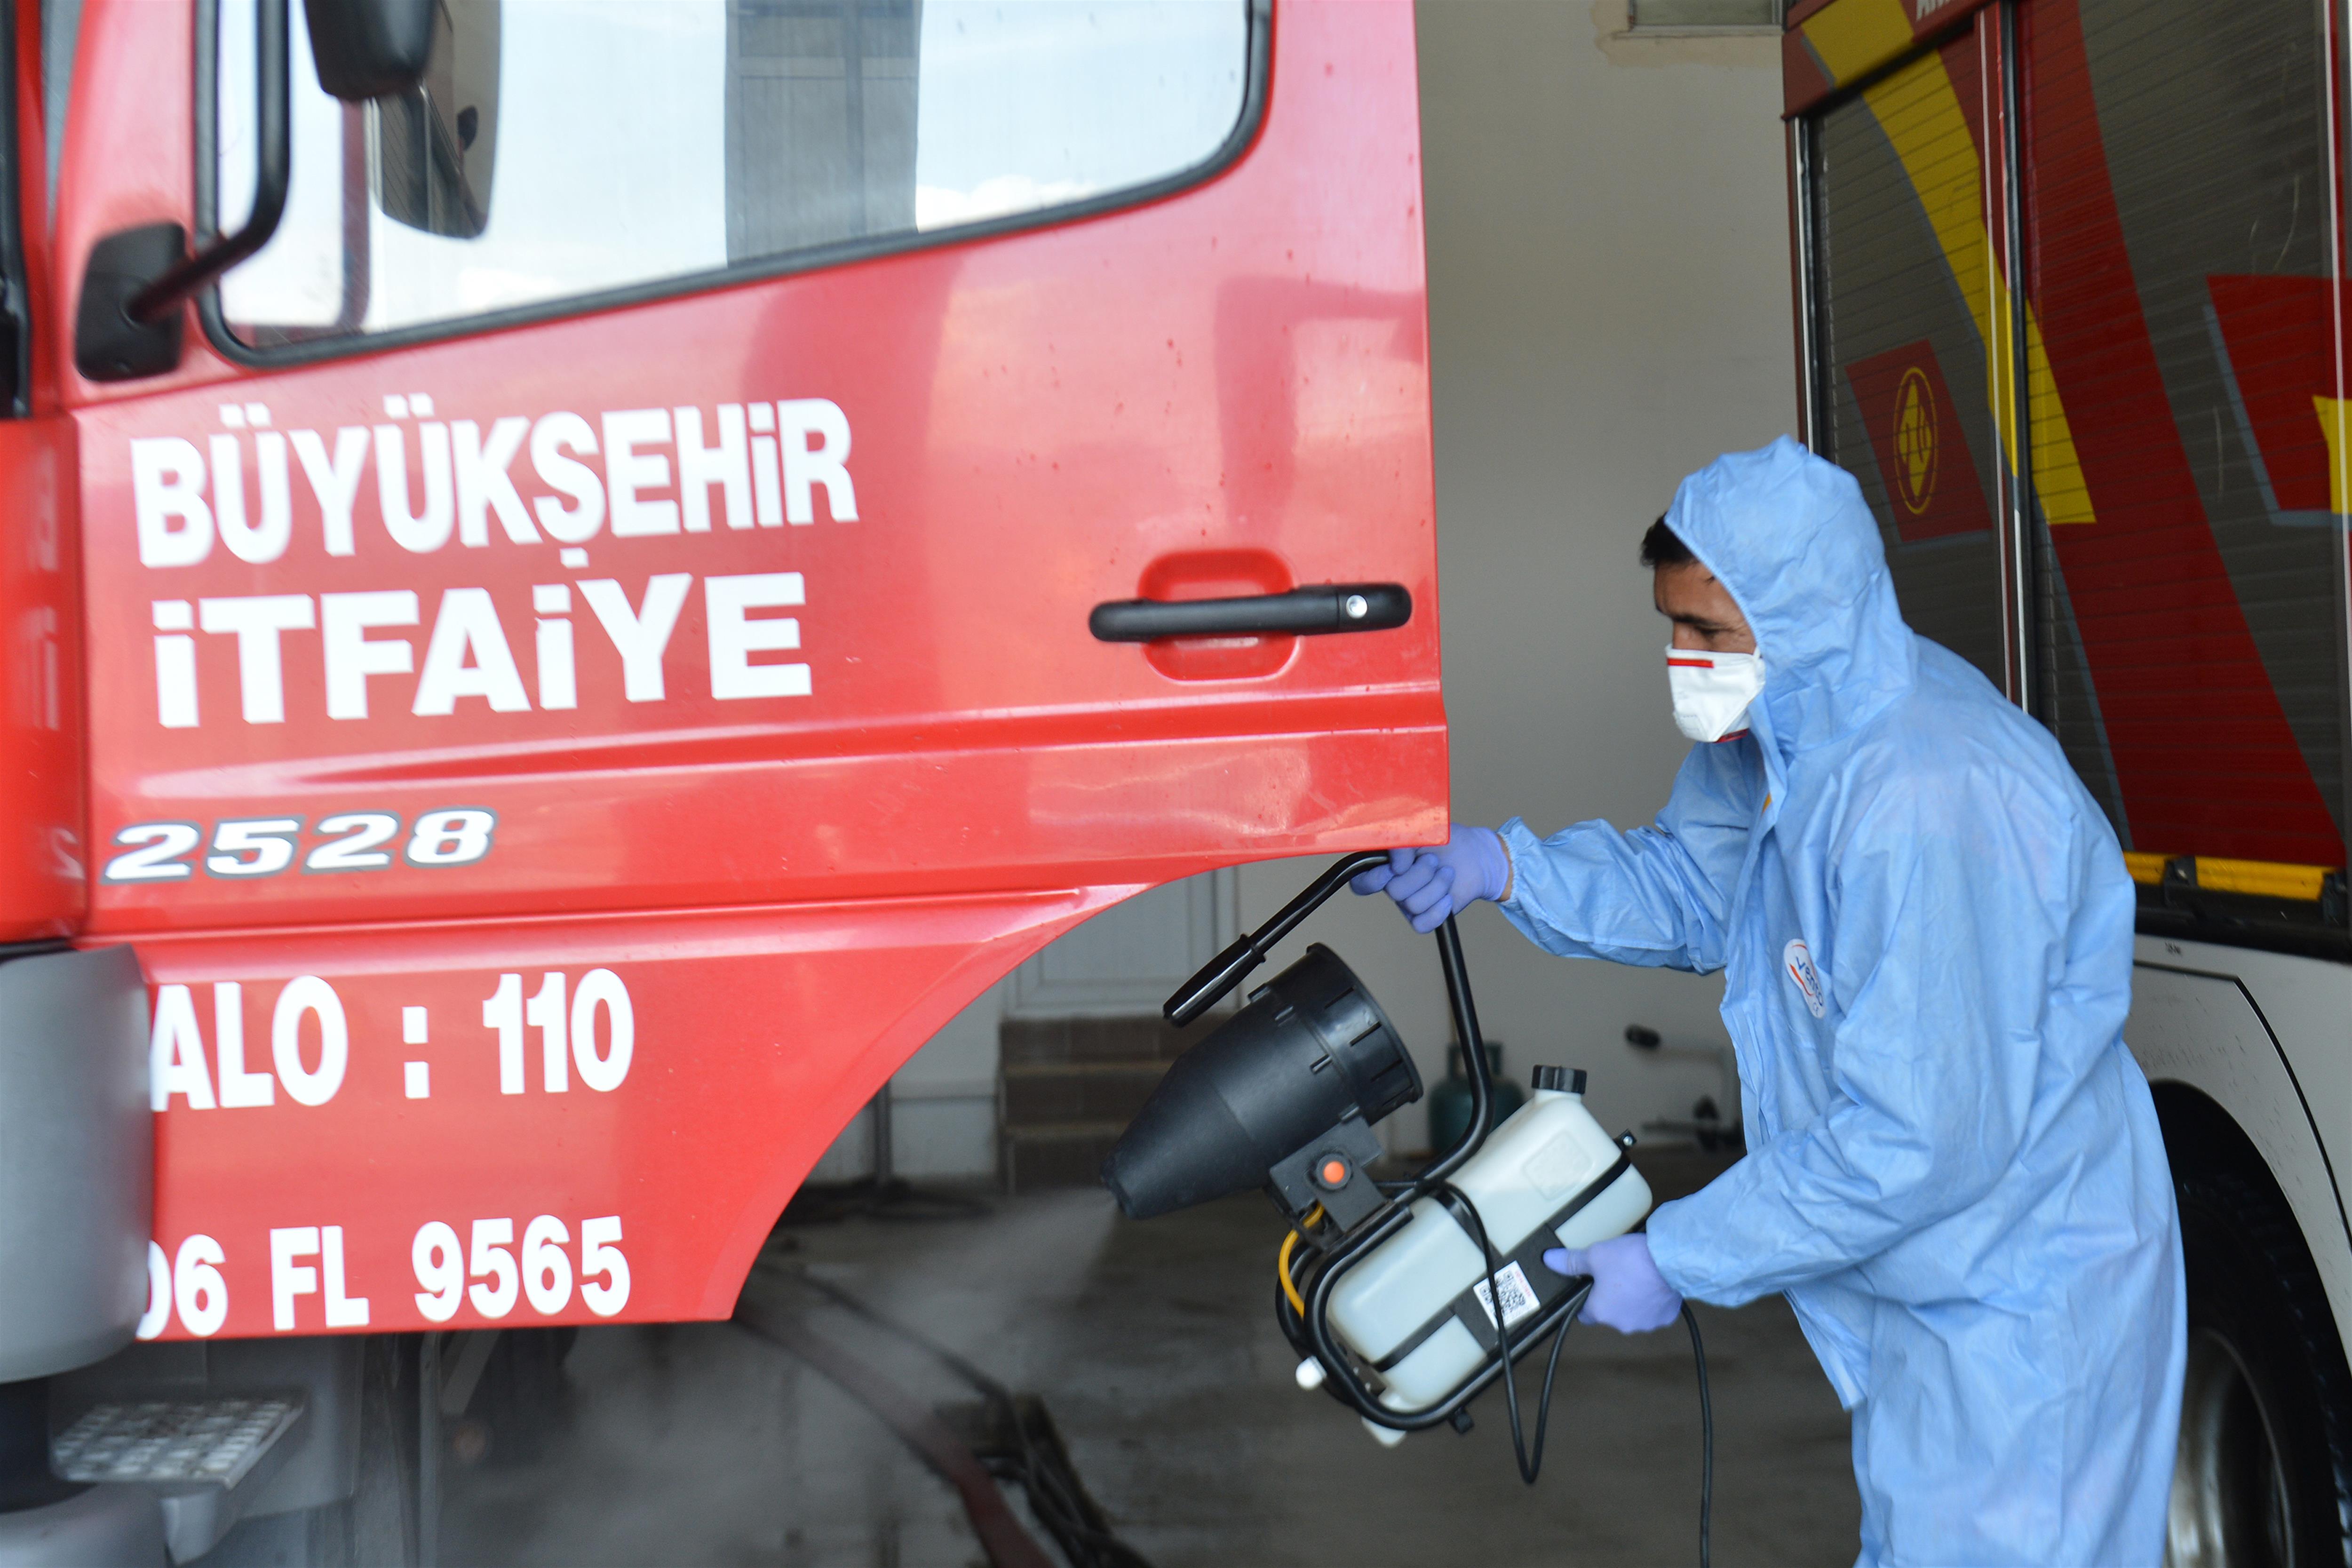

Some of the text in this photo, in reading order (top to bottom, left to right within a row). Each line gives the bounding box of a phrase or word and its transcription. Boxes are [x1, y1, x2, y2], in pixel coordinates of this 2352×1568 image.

[101, 806, 497, 883] 2528
[149, 971, 349, 1112] ALO
[482, 968, 635, 1095] 110
[270, 1226, 370, 1331] FL
[411, 1215, 631, 1322] 9565
